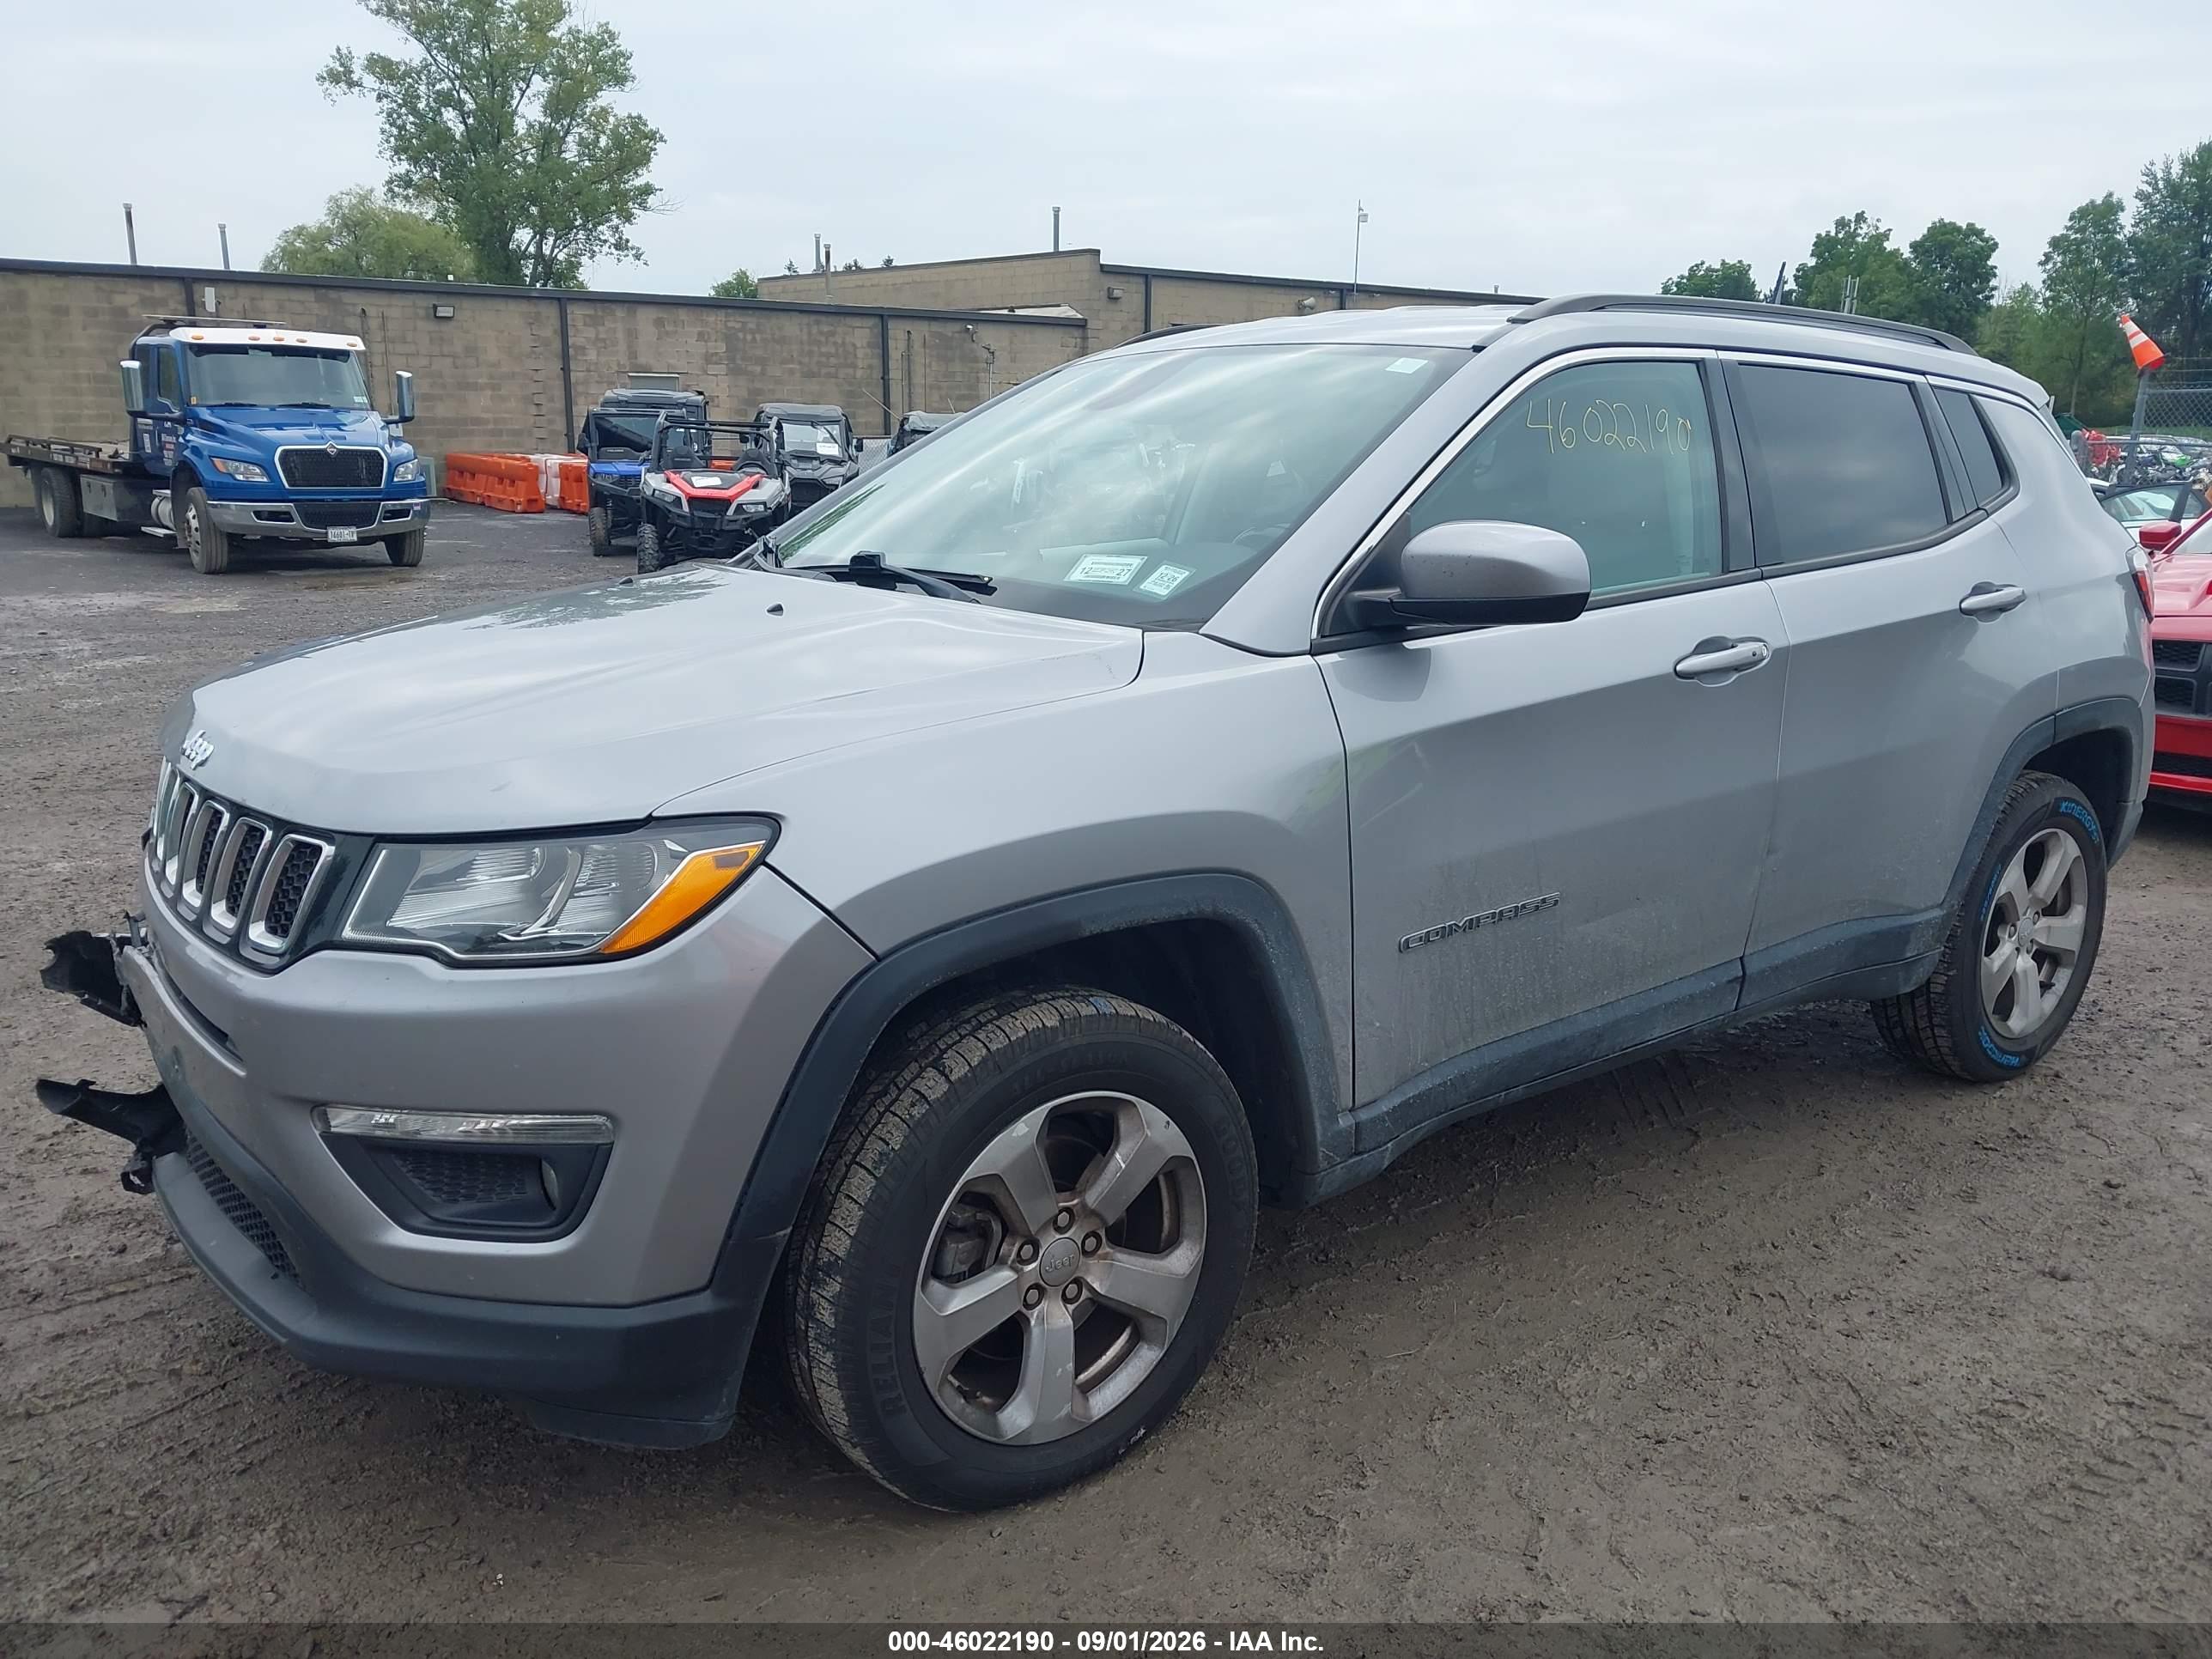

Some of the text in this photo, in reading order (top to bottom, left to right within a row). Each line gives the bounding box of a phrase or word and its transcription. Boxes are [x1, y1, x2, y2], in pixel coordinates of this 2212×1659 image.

[1526, 398, 1692, 455] 46022190
[1398, 891, 1560, 953] COMPASS
[1045, 1255, 1075, 1273] Jeep
